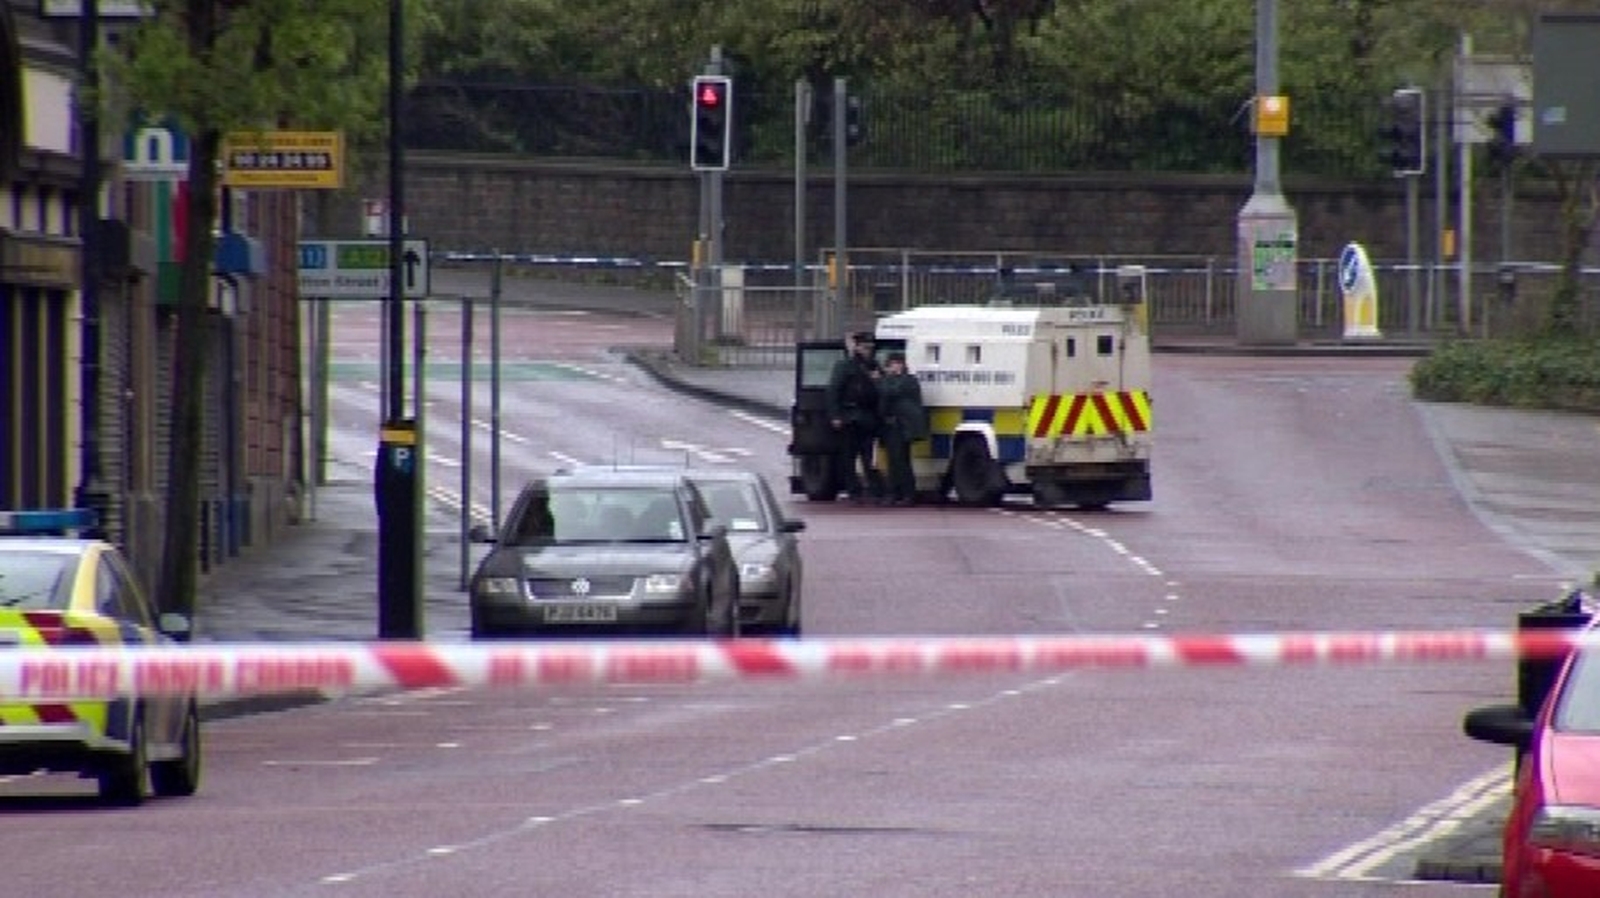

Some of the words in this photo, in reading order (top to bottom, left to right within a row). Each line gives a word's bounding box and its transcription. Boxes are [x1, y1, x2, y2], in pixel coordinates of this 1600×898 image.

[395, 447, 410, 467] P
[19, 658, 119, 697] POLICE
[133, 657, 225, 694] INNER
[236, 655, 355, 690] CORDON
